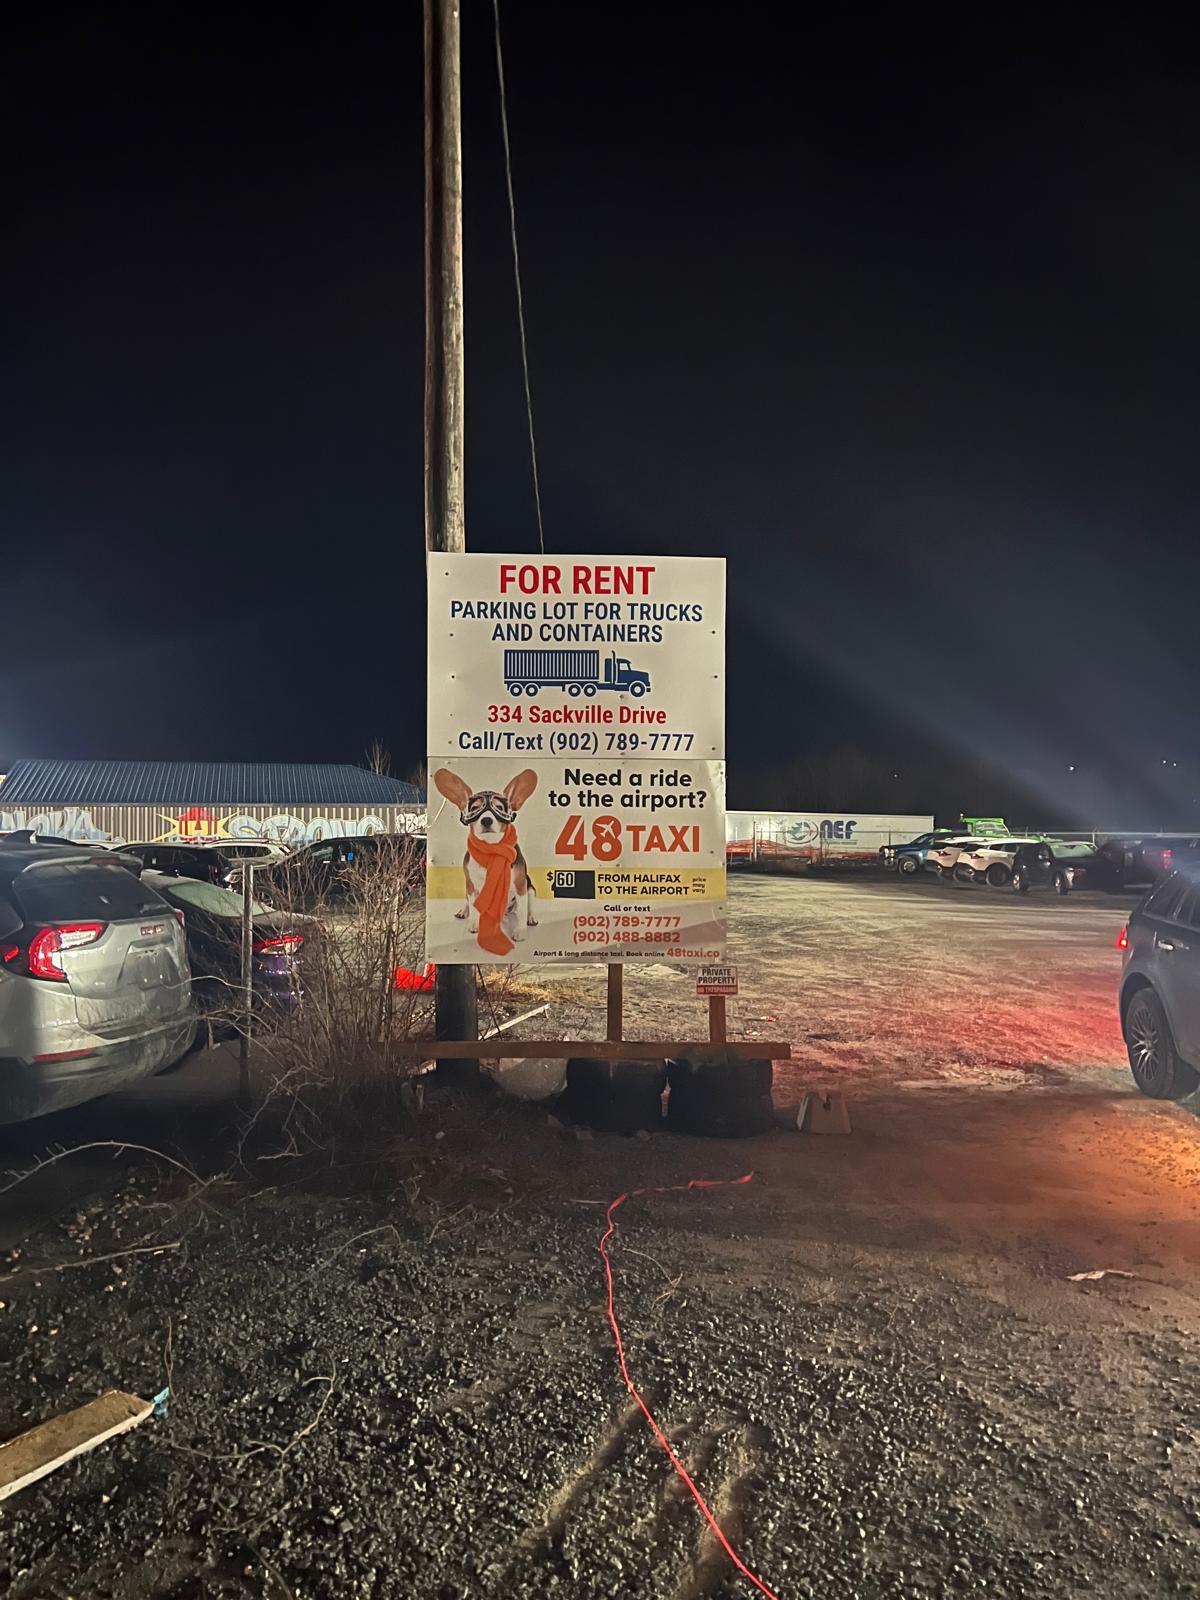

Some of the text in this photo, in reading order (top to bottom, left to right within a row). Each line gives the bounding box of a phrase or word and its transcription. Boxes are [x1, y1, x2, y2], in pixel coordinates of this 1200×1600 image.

[500, 564, 656, 595] FOR RENT
[451, 600, 703, 622] PARKING LOT FOR TRUCKS
[491, 623, 663, 643] AND CONTAINERS
[488, 705, 667, 724] 334 Sackville Drive
[458, 731, 695, 754] Call/Text (902) 789-7777
[564, 768, 692, 787] Need a ride
[548, 789, 707, 812] to the airport?
[555, 815, 700, 862] 48 TAXI
[598, 874, 681, 883] FROM HALIFAX
[598, 886, 689, 895] TO THE AIRPORT
[603, 904, 621, 912] Call
[634, 904, 650, 912] text
[573, 915, 681, 929] (902) 789-7777
[573, 931, 681, 945] (902) 488-8882
[533, 951, 557, 959] Airport
[564, 951, 579, 959] long
[666, 948, 720, 959] 48taxi.co
[698, 976, 736, 984] PROPERTY
[702, 968, 732, 976] PRIVATE
